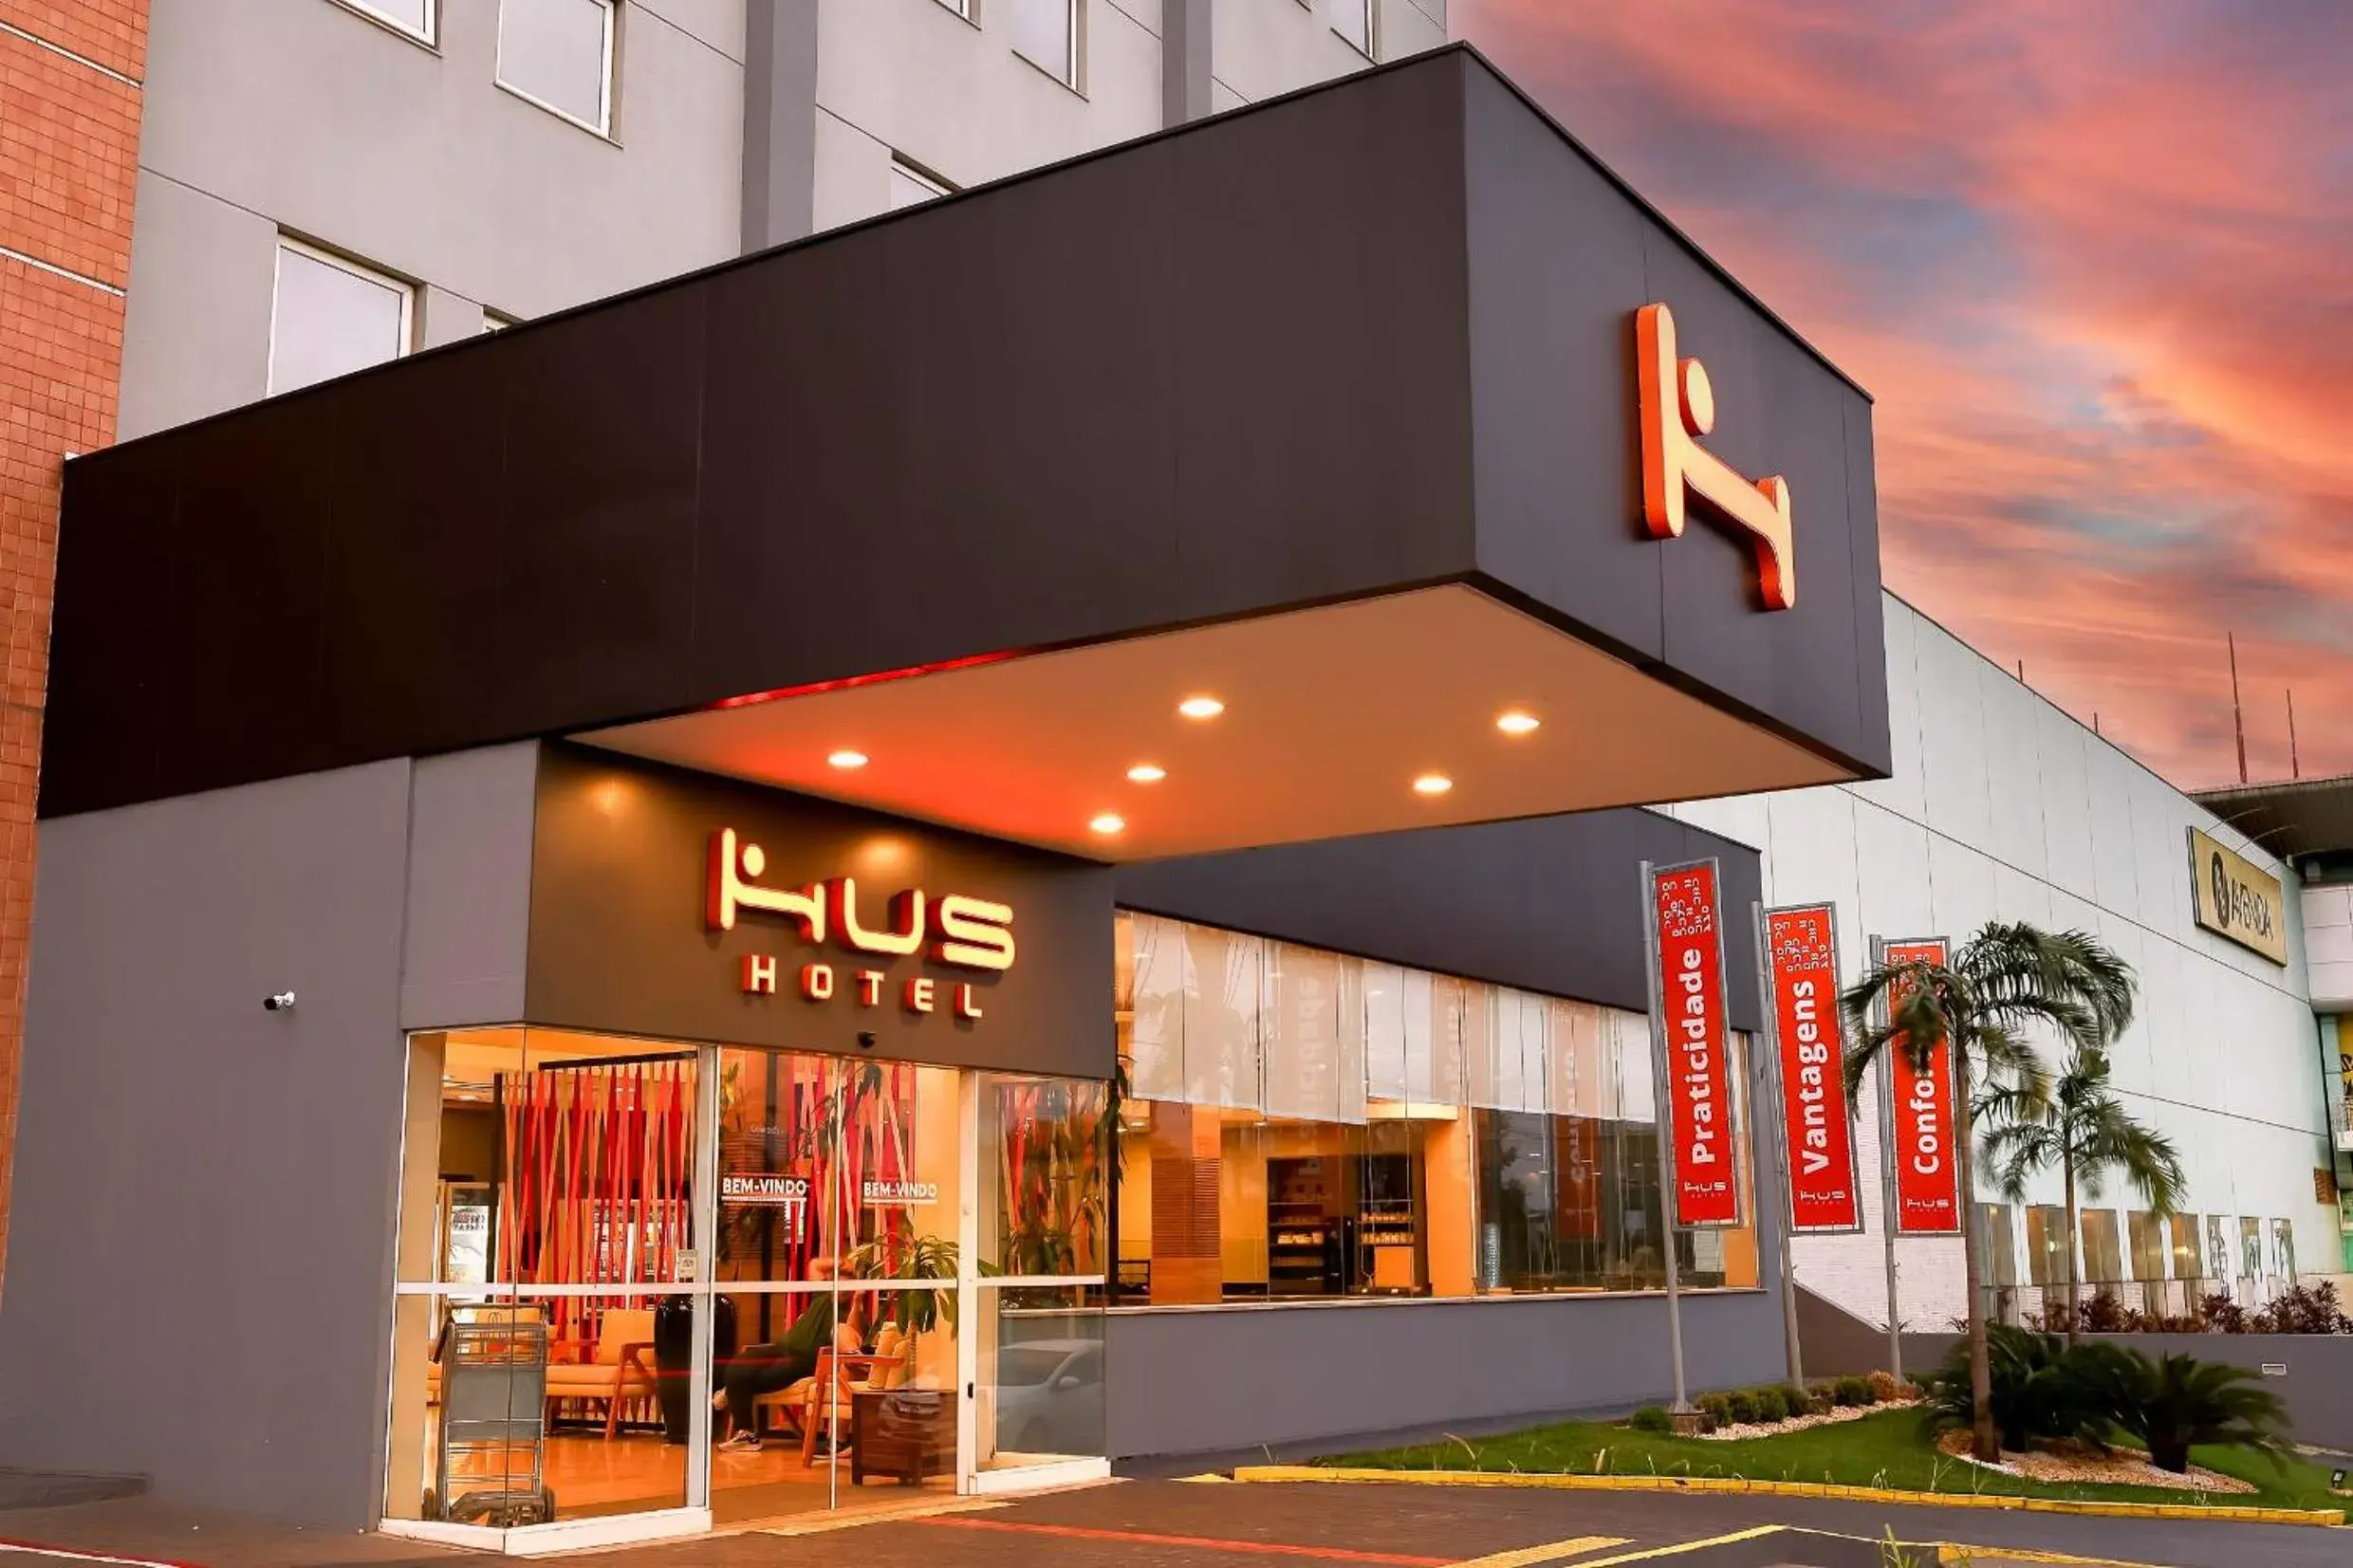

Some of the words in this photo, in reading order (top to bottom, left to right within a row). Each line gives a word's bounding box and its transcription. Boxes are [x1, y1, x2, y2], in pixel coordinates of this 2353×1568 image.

[743, 953, 983, 1019] HOTEL
[1678, 948, 1715, 1164] Praticidade
[1792, 980, 1829, 1175] Vantagens
[722, 1177, 806, 1194] BEM-VINDO
[863, 1181, 937, 1197] BEM-VINDO
